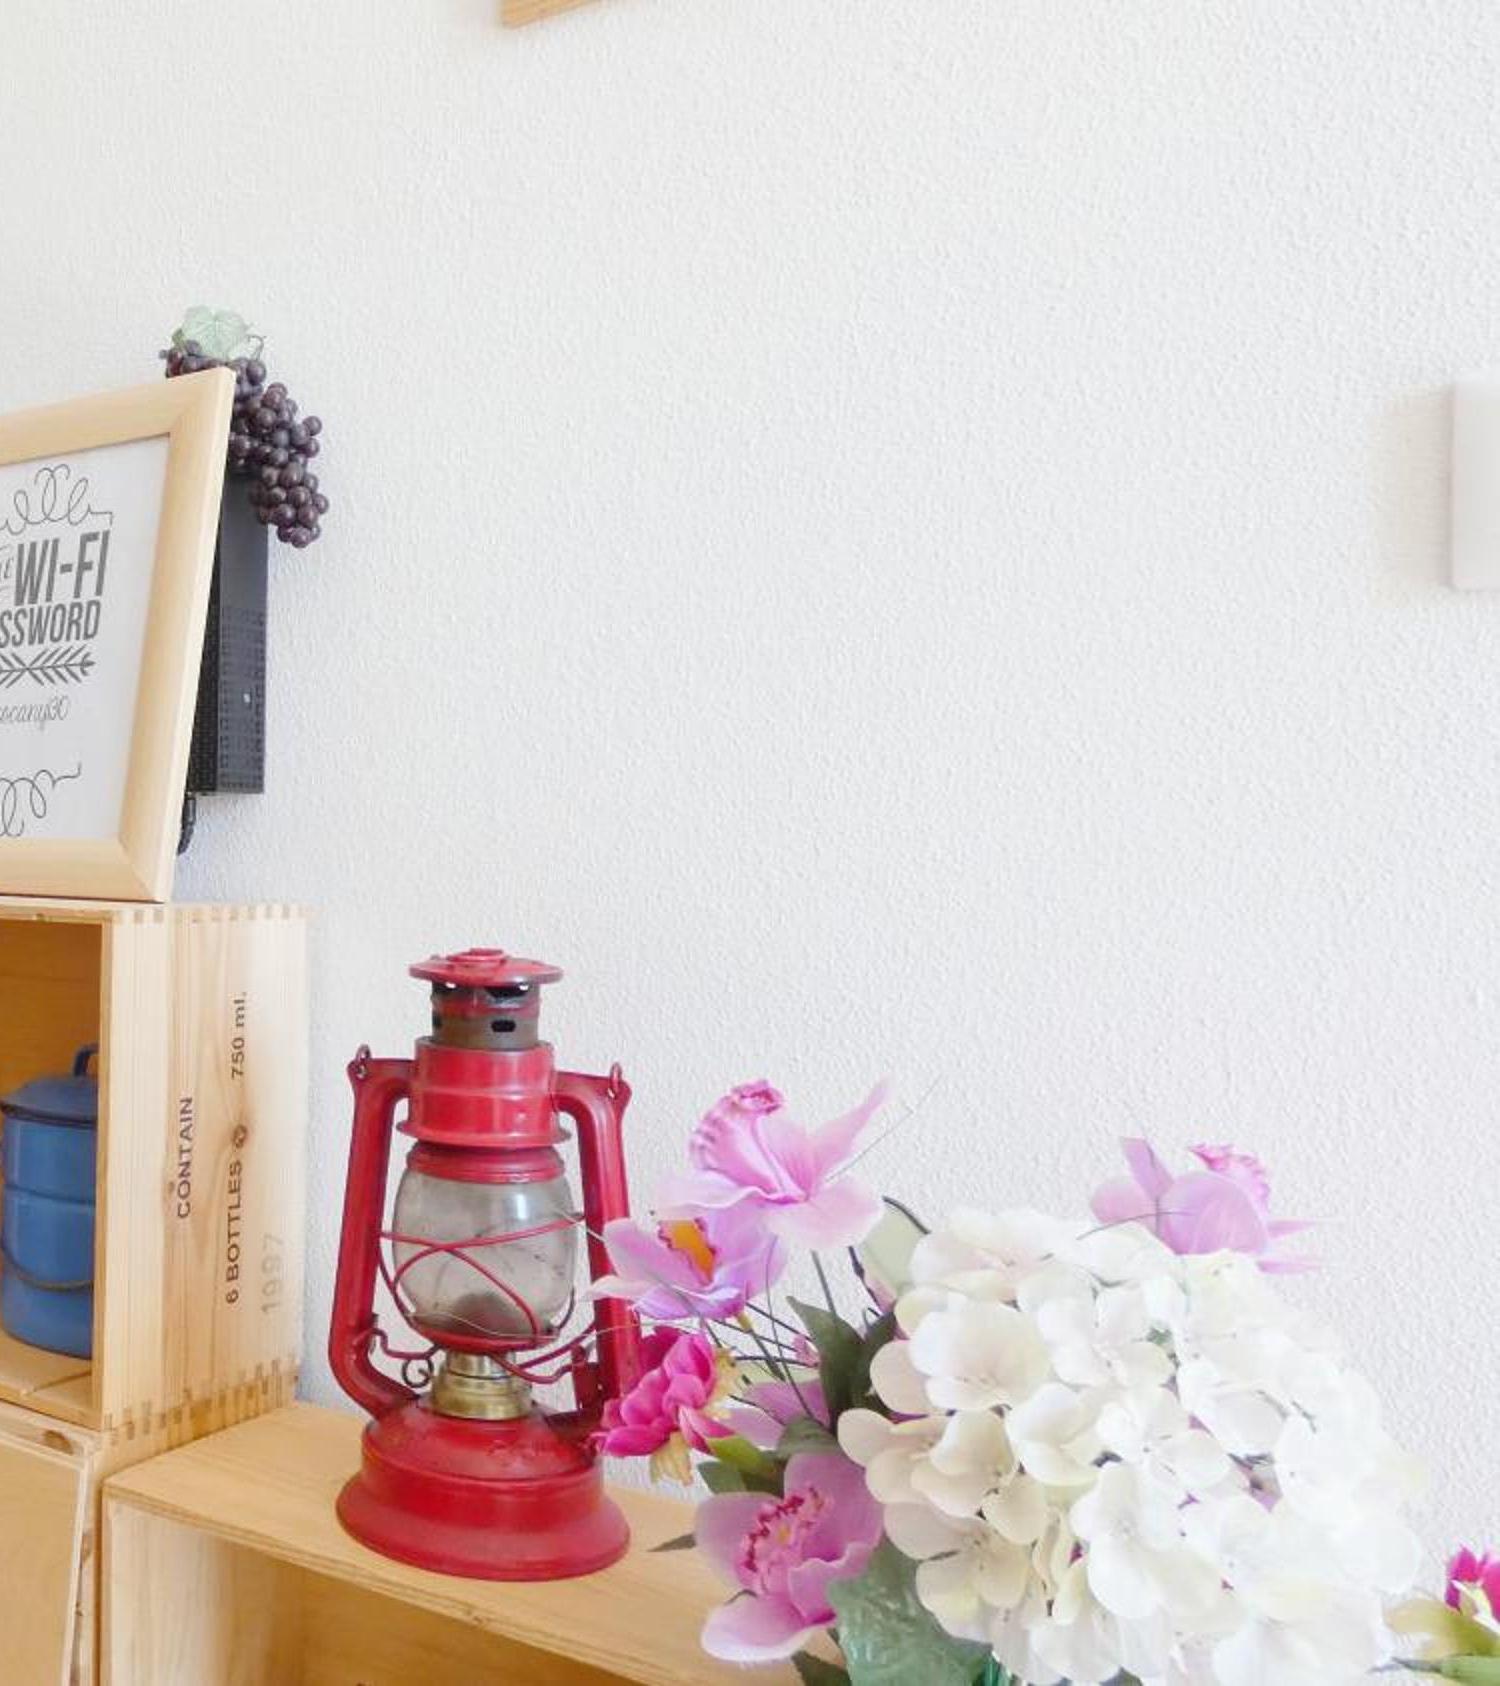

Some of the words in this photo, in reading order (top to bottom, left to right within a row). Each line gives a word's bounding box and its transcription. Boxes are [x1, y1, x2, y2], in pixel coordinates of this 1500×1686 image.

[14, 529, 111, 607] WI-FI
[231, 1036, 245, 1081] 750
[176, 1097, 193, 1219] CONTAIN
[226, 1161, 243, 1283] BOTTLES
[225, 1289, 239, 1304] 6
[262, 1232, 285, 1315] 1997
